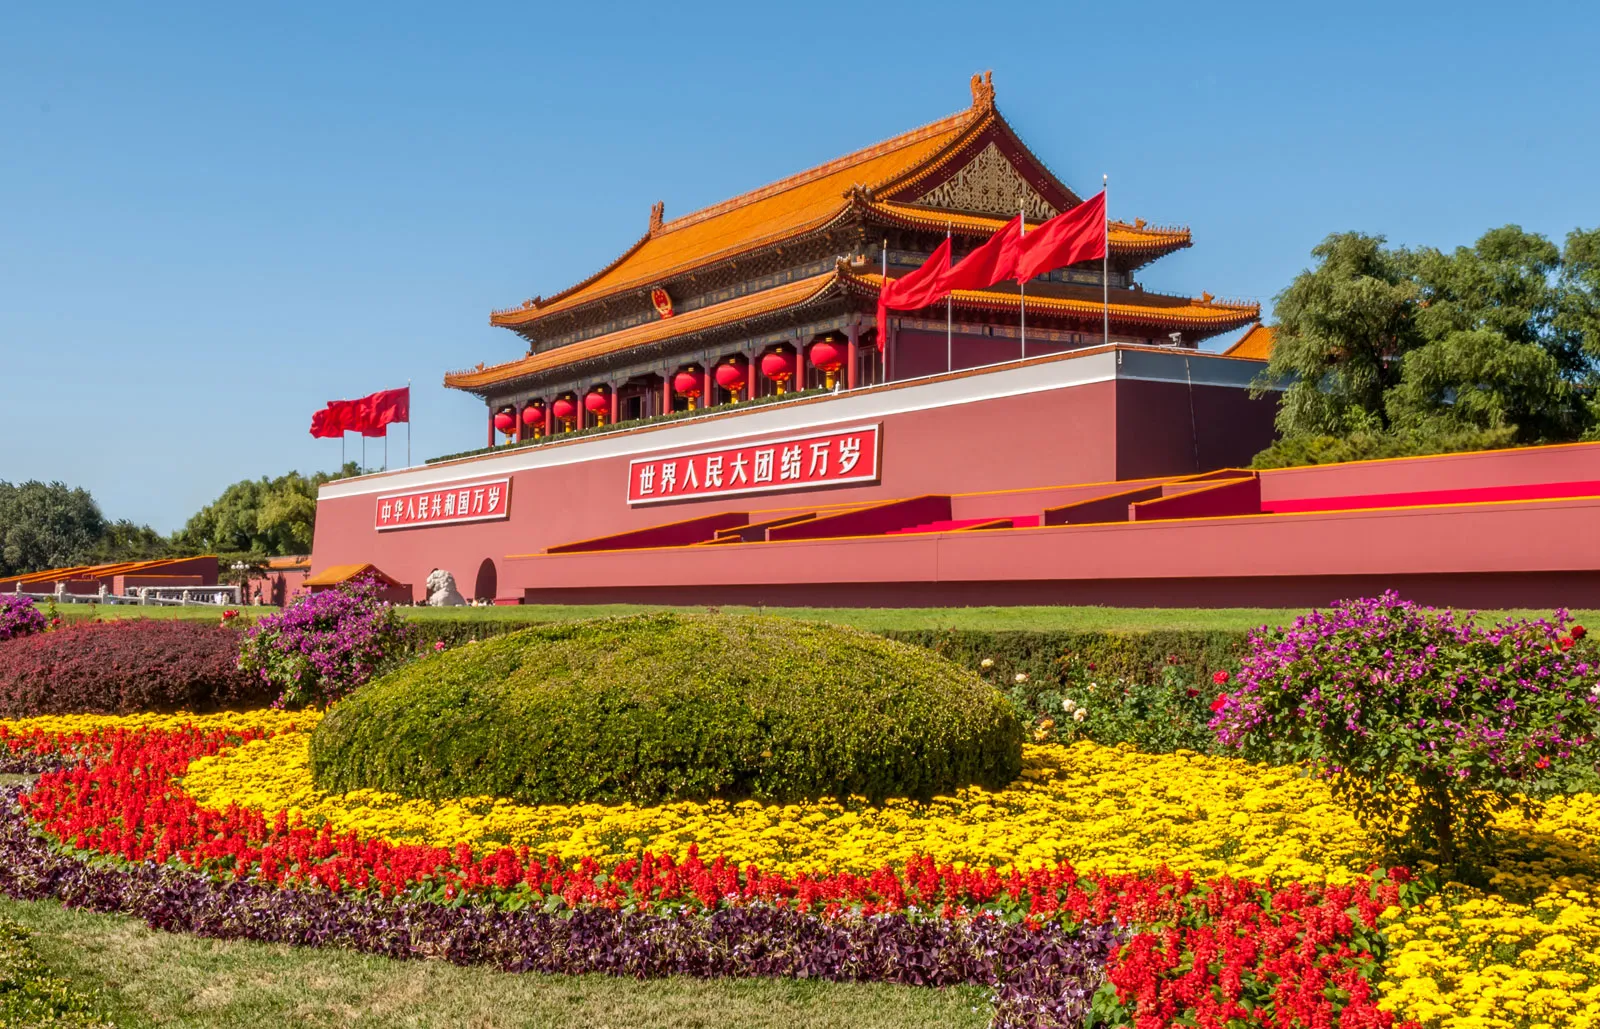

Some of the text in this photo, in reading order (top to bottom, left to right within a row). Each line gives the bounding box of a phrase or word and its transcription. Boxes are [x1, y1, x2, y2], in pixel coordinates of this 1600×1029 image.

[639, 437, 861, 496] 世界人民大团结万岁
[381, 486, 500, 523] 中华人民共和国万岁
